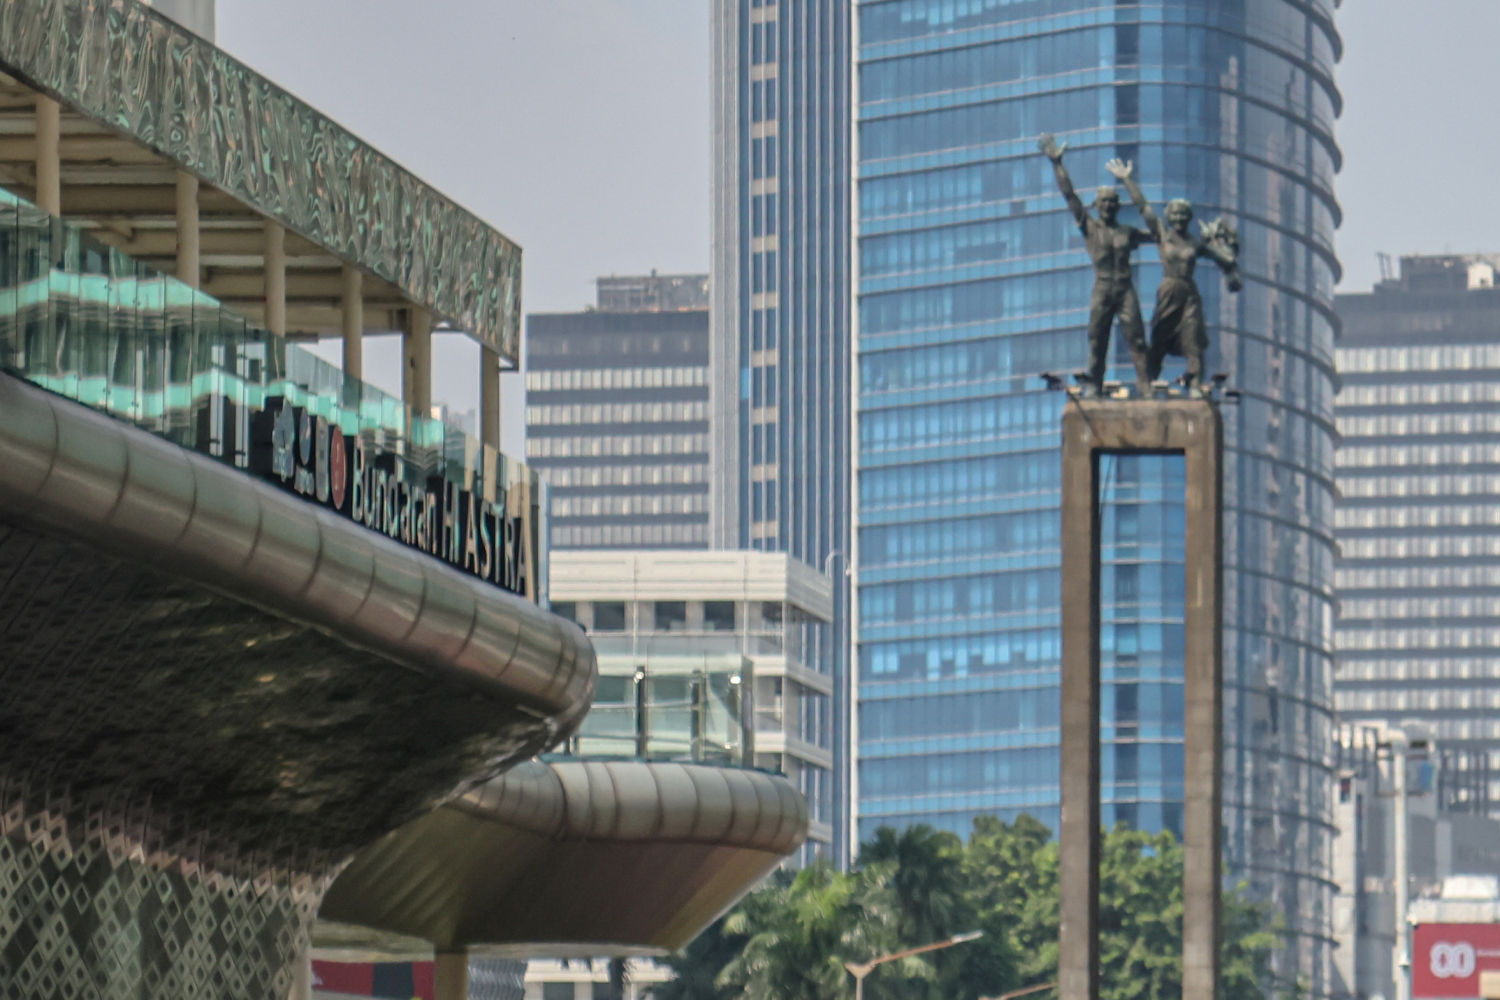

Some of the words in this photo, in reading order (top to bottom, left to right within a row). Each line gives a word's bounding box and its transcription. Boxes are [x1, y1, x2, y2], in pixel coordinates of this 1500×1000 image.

[352, 436, 437, 555] Bundaran
[442, 475, 460, 564] HI
[464, 490, 531, 597] ASTRA
